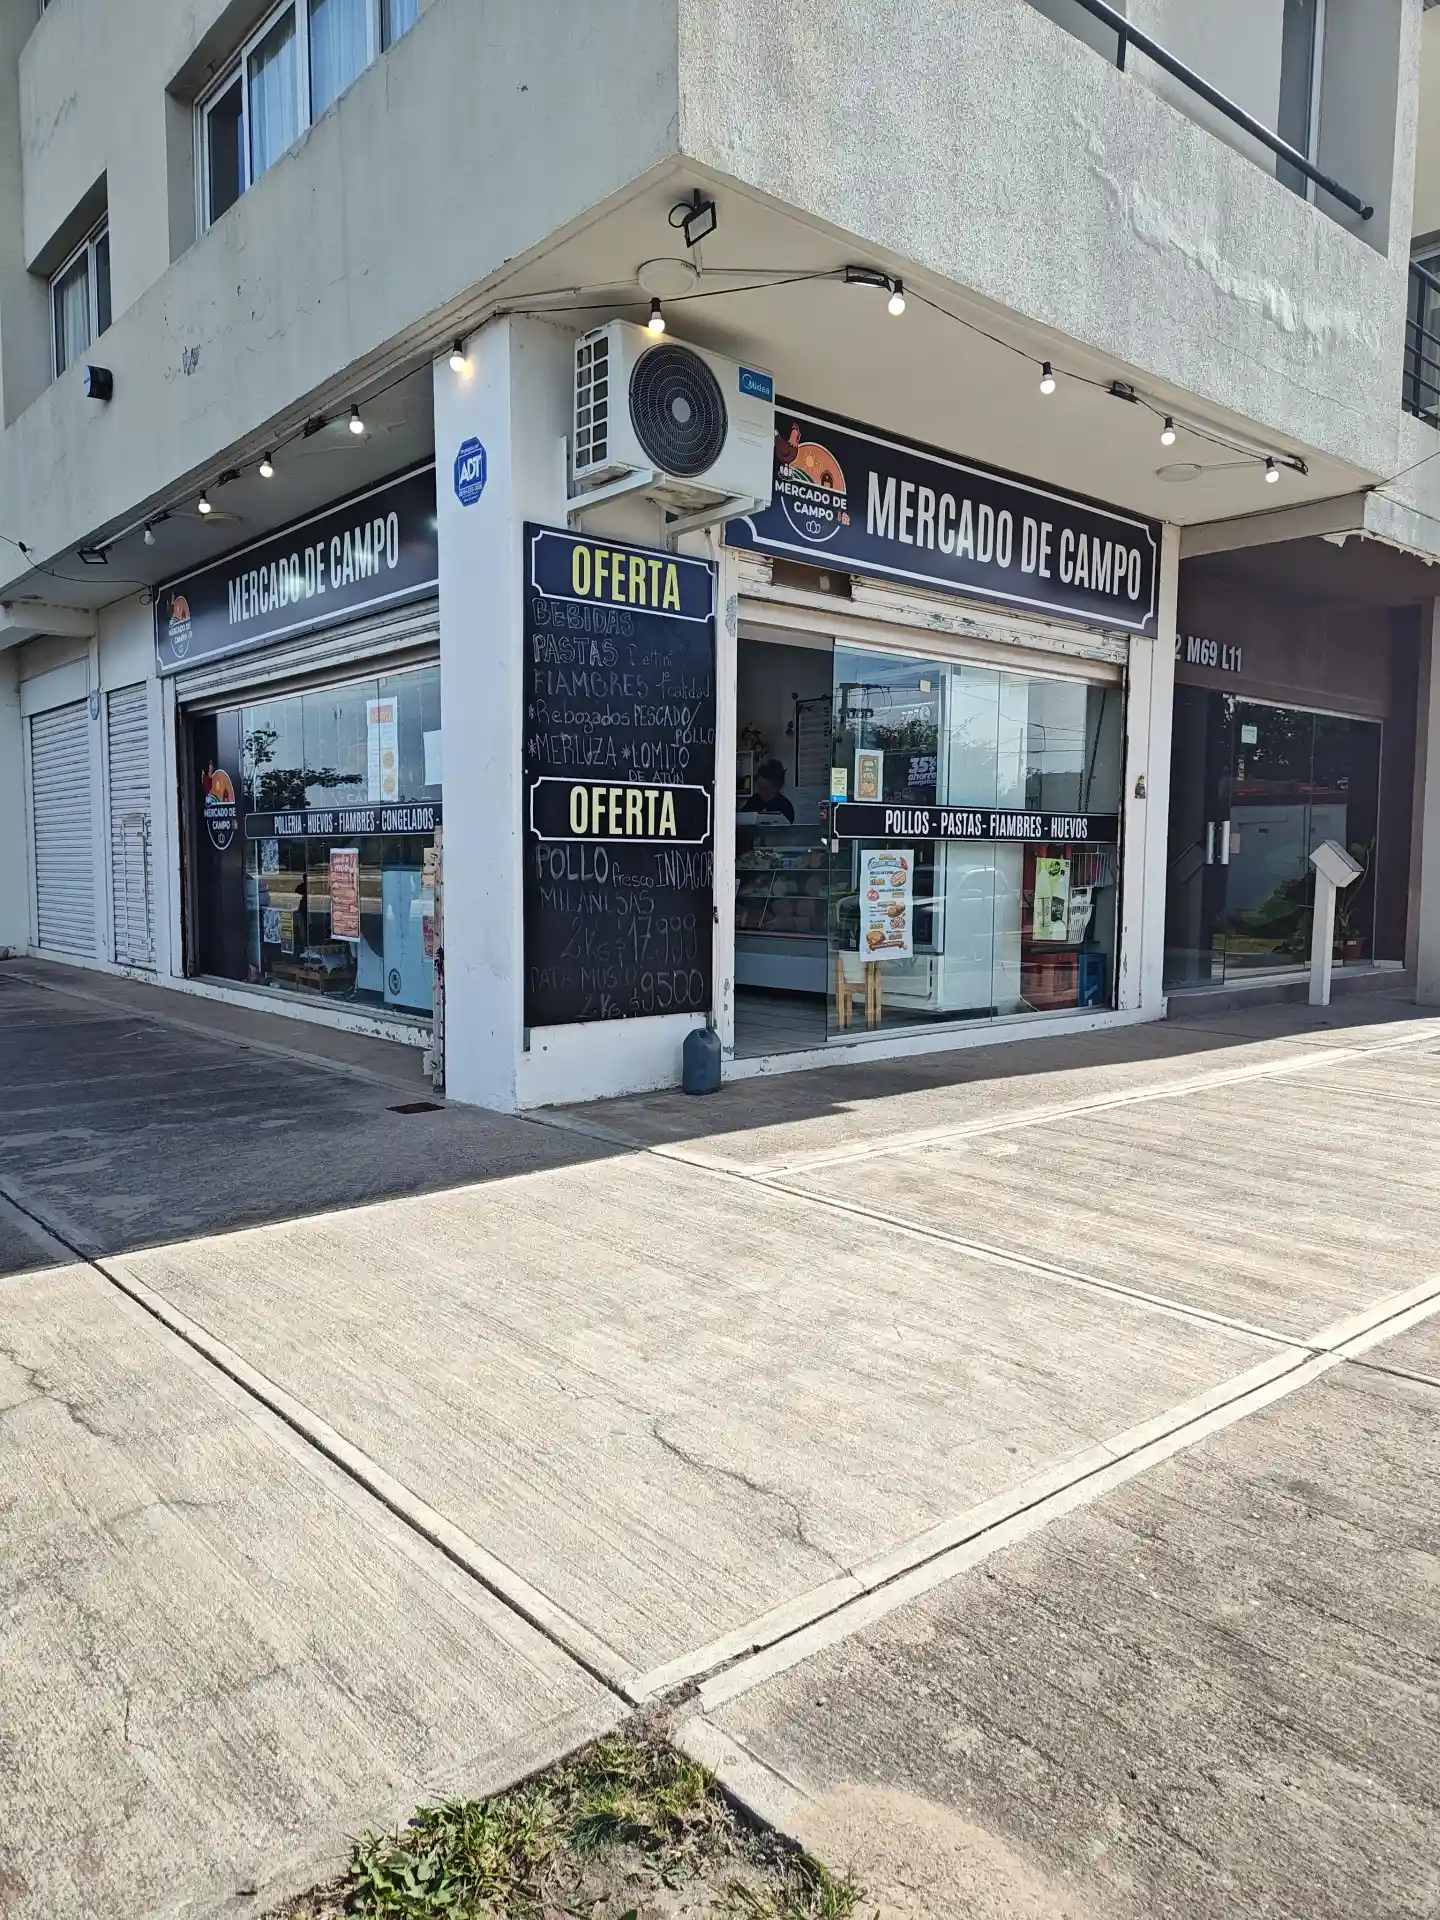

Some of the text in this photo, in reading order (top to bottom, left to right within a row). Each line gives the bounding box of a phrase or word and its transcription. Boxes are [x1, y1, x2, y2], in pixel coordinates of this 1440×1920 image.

[742, 373, 770, 395] Midea
[460, 454, 481, 485] ADT
[775, 479, 847, 510] MERCADO DE
[794, 501, 834, 521] CAMPO
[866, 470, 1142, 600] MERCADO DE CAMPO
[228, 511, 399, 625] MERCADO DE CAMPO
[572, 545, 681, 611] OFERTA
[532, 598, 634, 636] BEBIDAS
[532, 634, 618, 667] PASTAS
[1187, 635, 1218, 667] M69
[1222, 643, 1242, 672] L11
[534, 669, 648, 699] FIAMBRES
[628, 769, 647, 783] DE
[204, 807, 236, 818] MERCADO DE
[212, 820, 231, 830] CAMPO
[274, 808, 434, 835] POLLERIA HUEVOS FIAMBRES CONGELADOS
[570, 785, 677, 836] OFERTA
[885, 809, 930, 835] POLLOS
[989, 814, 1042, 838] FIAMBRES
[1050, 817, 1088, 839] HUEVOS
[536, 844, 609, 884] POLLO
[612, 861, 654, 889] fresco
